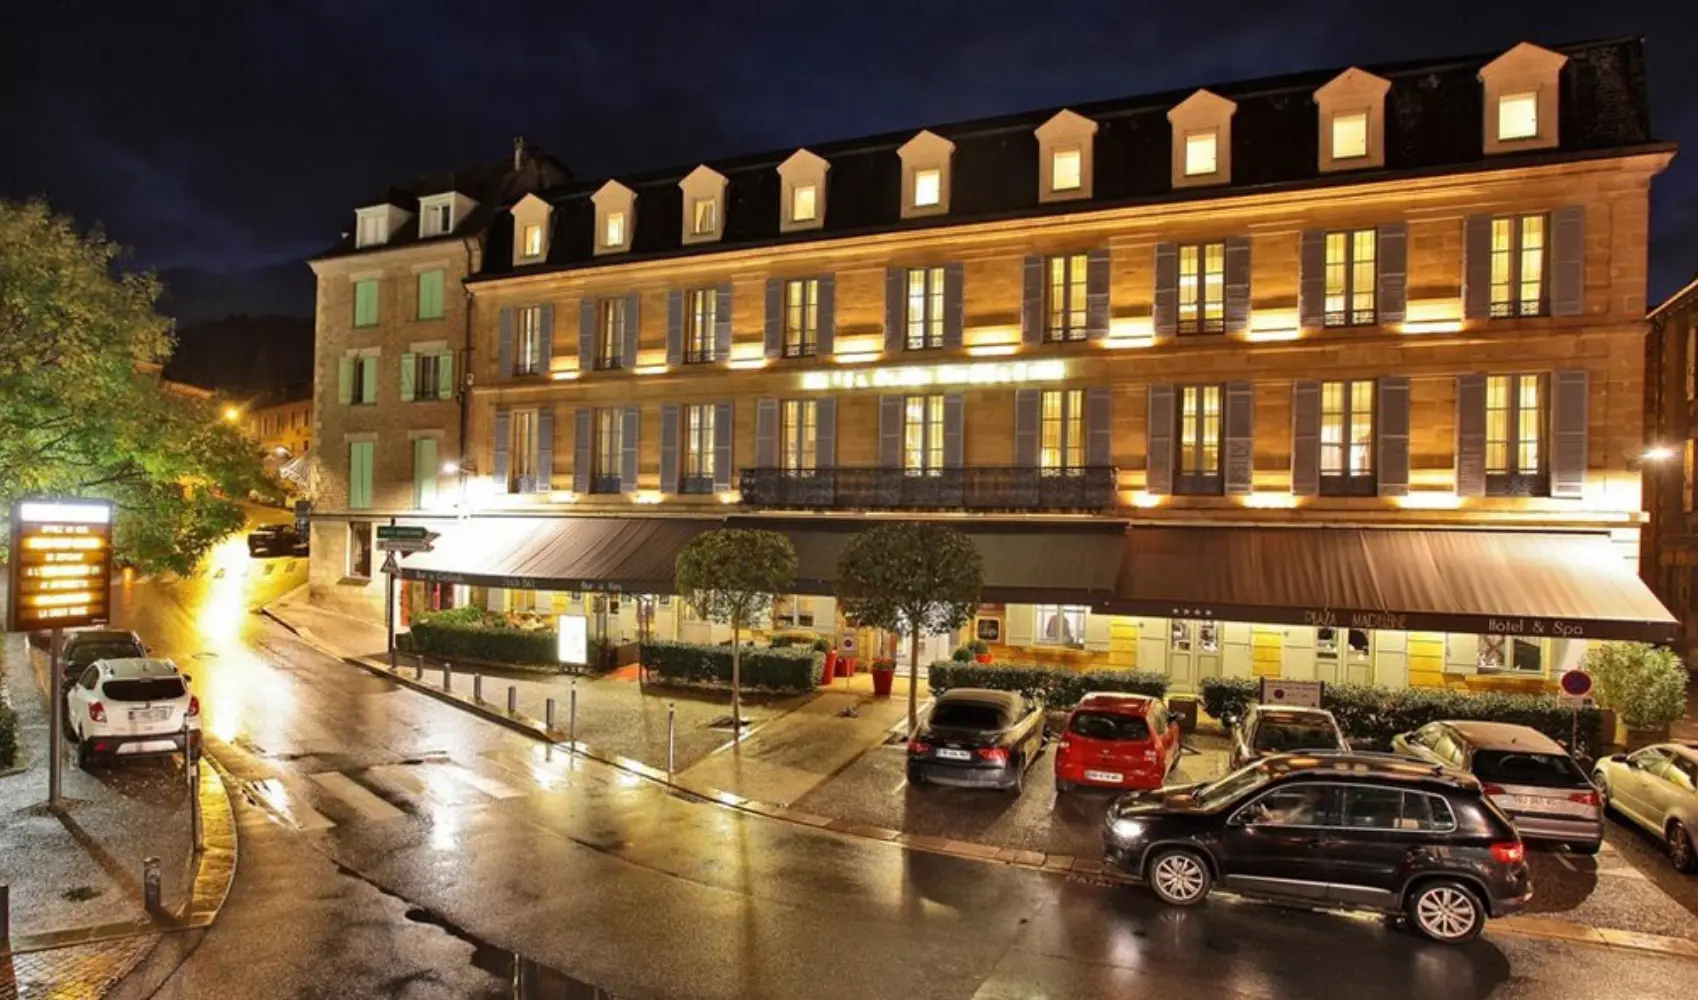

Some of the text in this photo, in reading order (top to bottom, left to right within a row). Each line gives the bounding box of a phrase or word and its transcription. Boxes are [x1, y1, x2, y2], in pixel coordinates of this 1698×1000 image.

[1303, 609, 1337, 625] PLAZA
[1532, 619, 1545, 633] &
[1552, 620, 1584, 637] Spa
